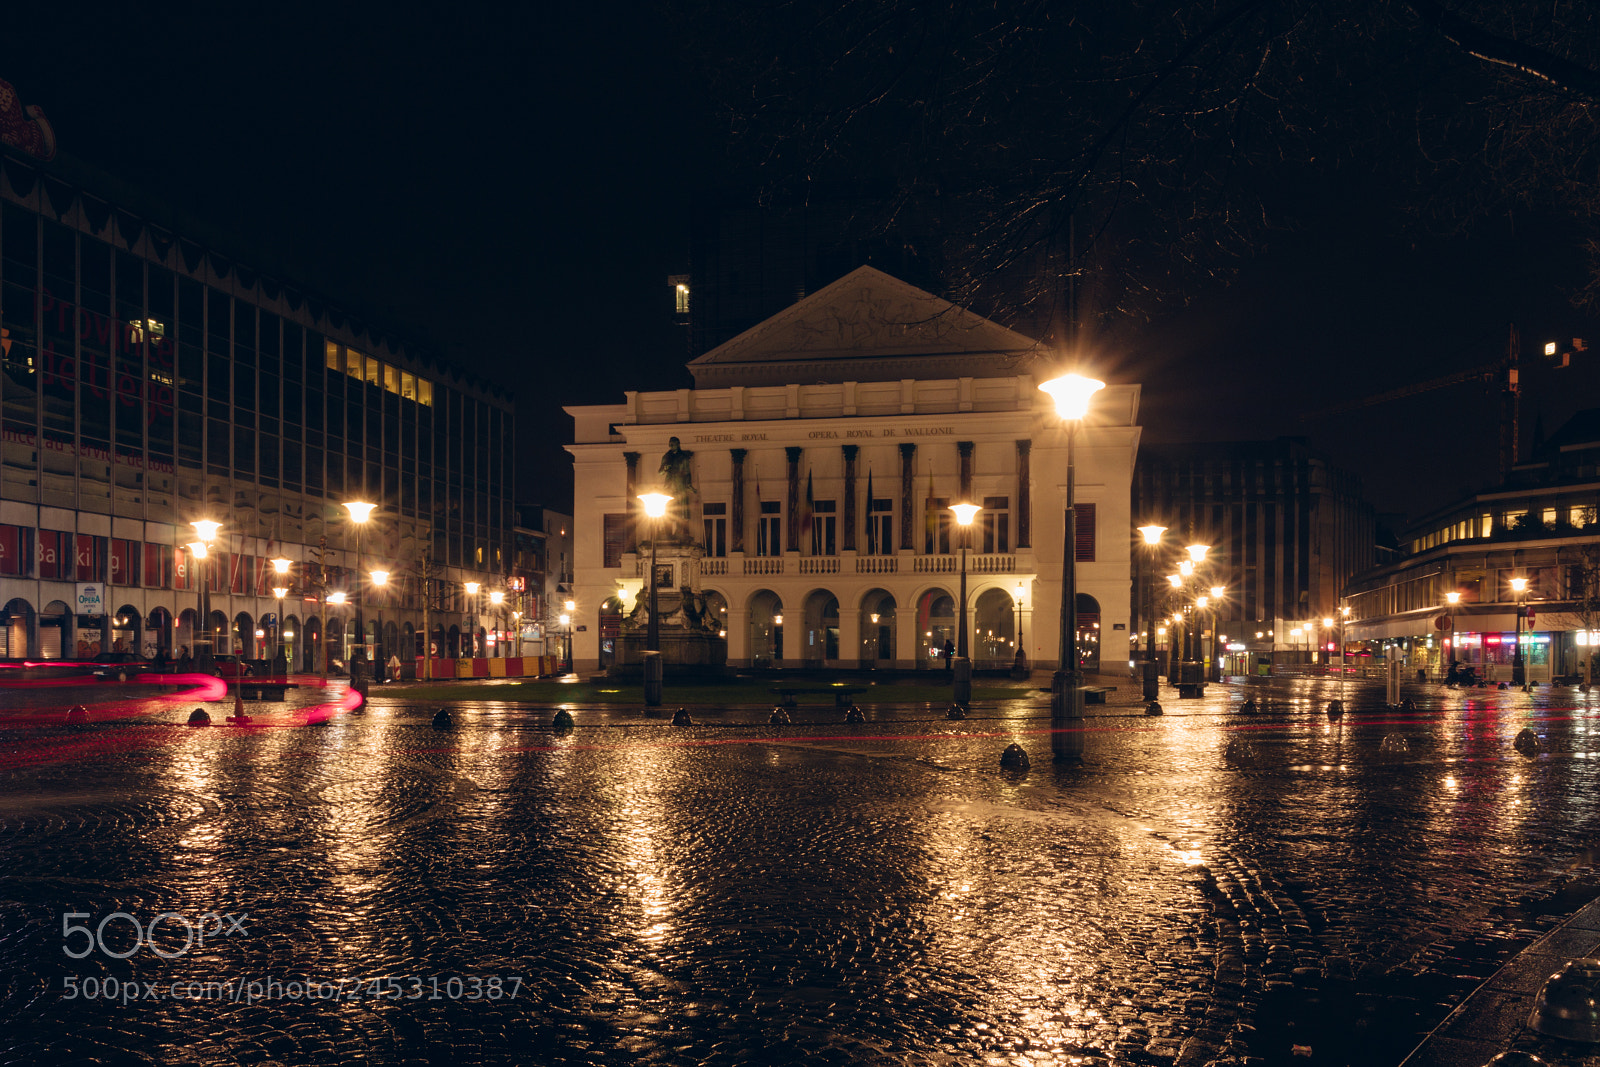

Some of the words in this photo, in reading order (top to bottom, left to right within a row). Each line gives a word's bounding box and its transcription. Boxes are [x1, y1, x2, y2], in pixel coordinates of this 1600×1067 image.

[33, 284, 173, 368] Province
[33, 341, 76, 391] de
[89, 354, 173, 426] Liège
[694, 434, 734, 443] THEATRE
[741, 433, 768, 442] ROYAL
[808, 430, 839, 439] OPERA
[846, 429, 874, 438] ROYAL
[883, 428, 896, 437] DE
[45, 434, 64, 451] au
[70, 440, 121, 463] service
[127, 449, 142, 467] de
[148, 456, 174, 474] tous
[270, 614, 275, 622] P
